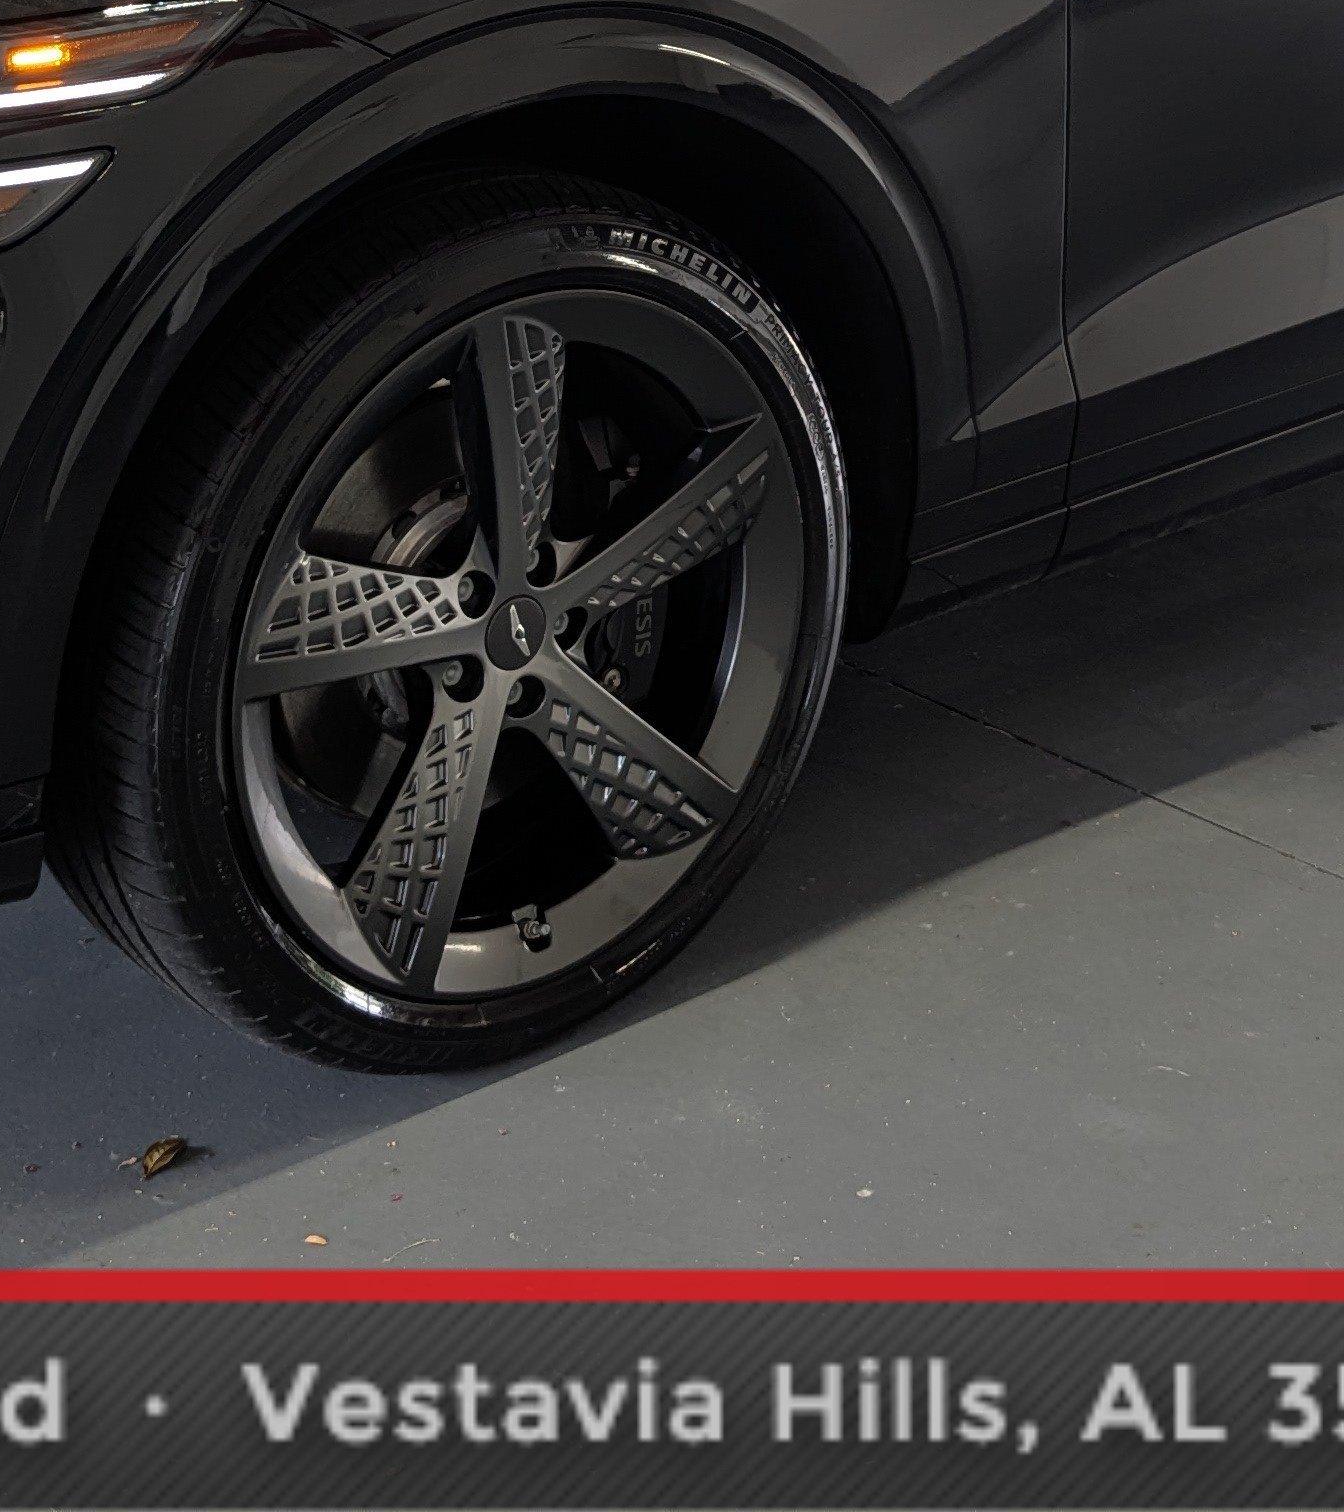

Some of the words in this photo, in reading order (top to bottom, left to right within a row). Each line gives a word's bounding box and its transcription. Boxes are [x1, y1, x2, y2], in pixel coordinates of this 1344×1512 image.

[608, 227, 752, 306] MICHELIN
[764, 312, 813, 387] PRIMACY
[633, 592, 654, 658] ESIS
